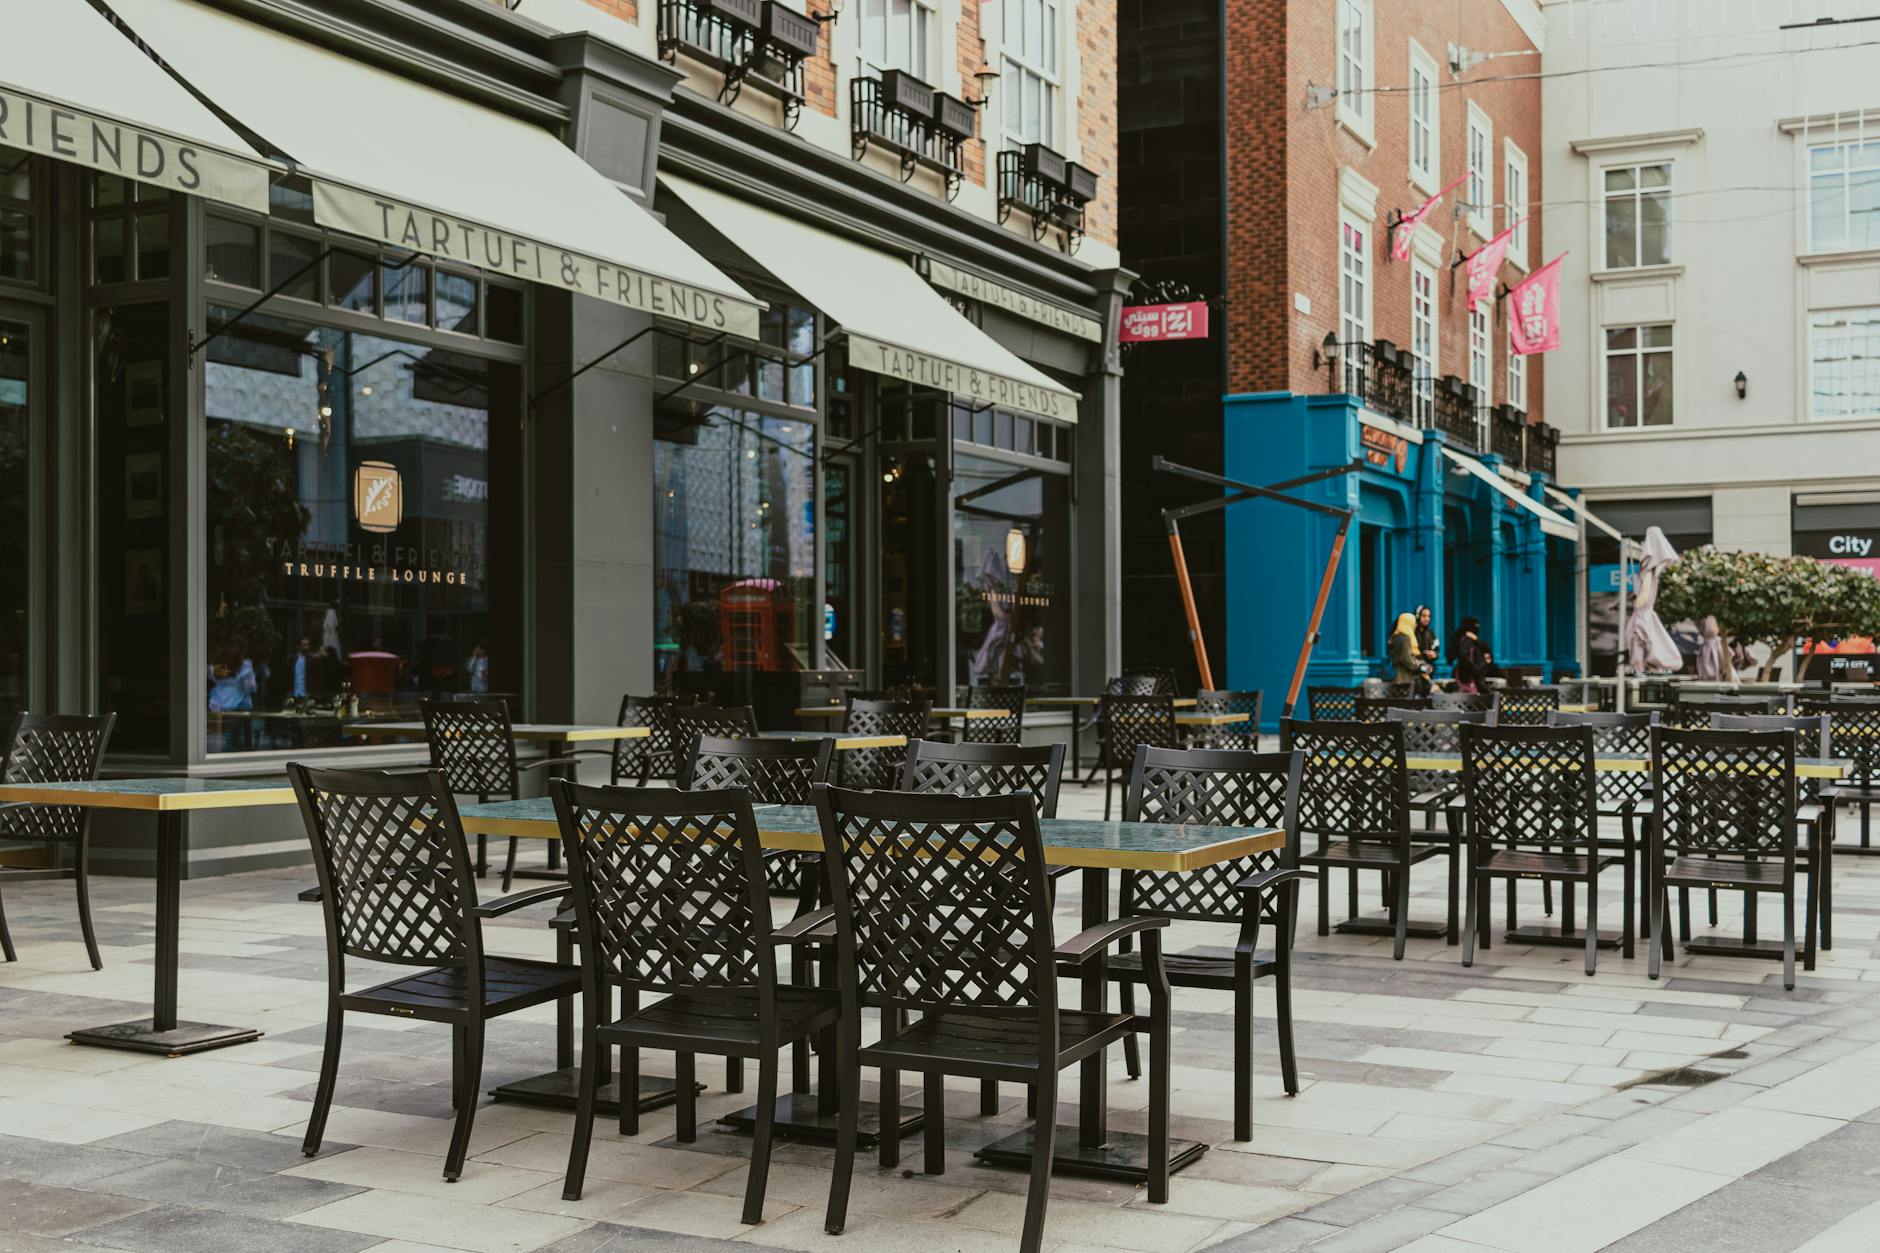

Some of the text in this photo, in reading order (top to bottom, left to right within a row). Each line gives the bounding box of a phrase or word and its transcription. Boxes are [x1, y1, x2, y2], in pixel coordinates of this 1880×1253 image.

[375, 200, 726, 328] TARTUFI & FRIENDS
[951, 270, 1014, 309] TARTUFI
[1032, 302, 1088, 336] FRIENDS
[878, 345, 1059, 416] TARTUFI & FRIENDS
[285, 562, 467, 585] TRUFFLE LOUNGE
[1828, 535, 1873, 557] City
